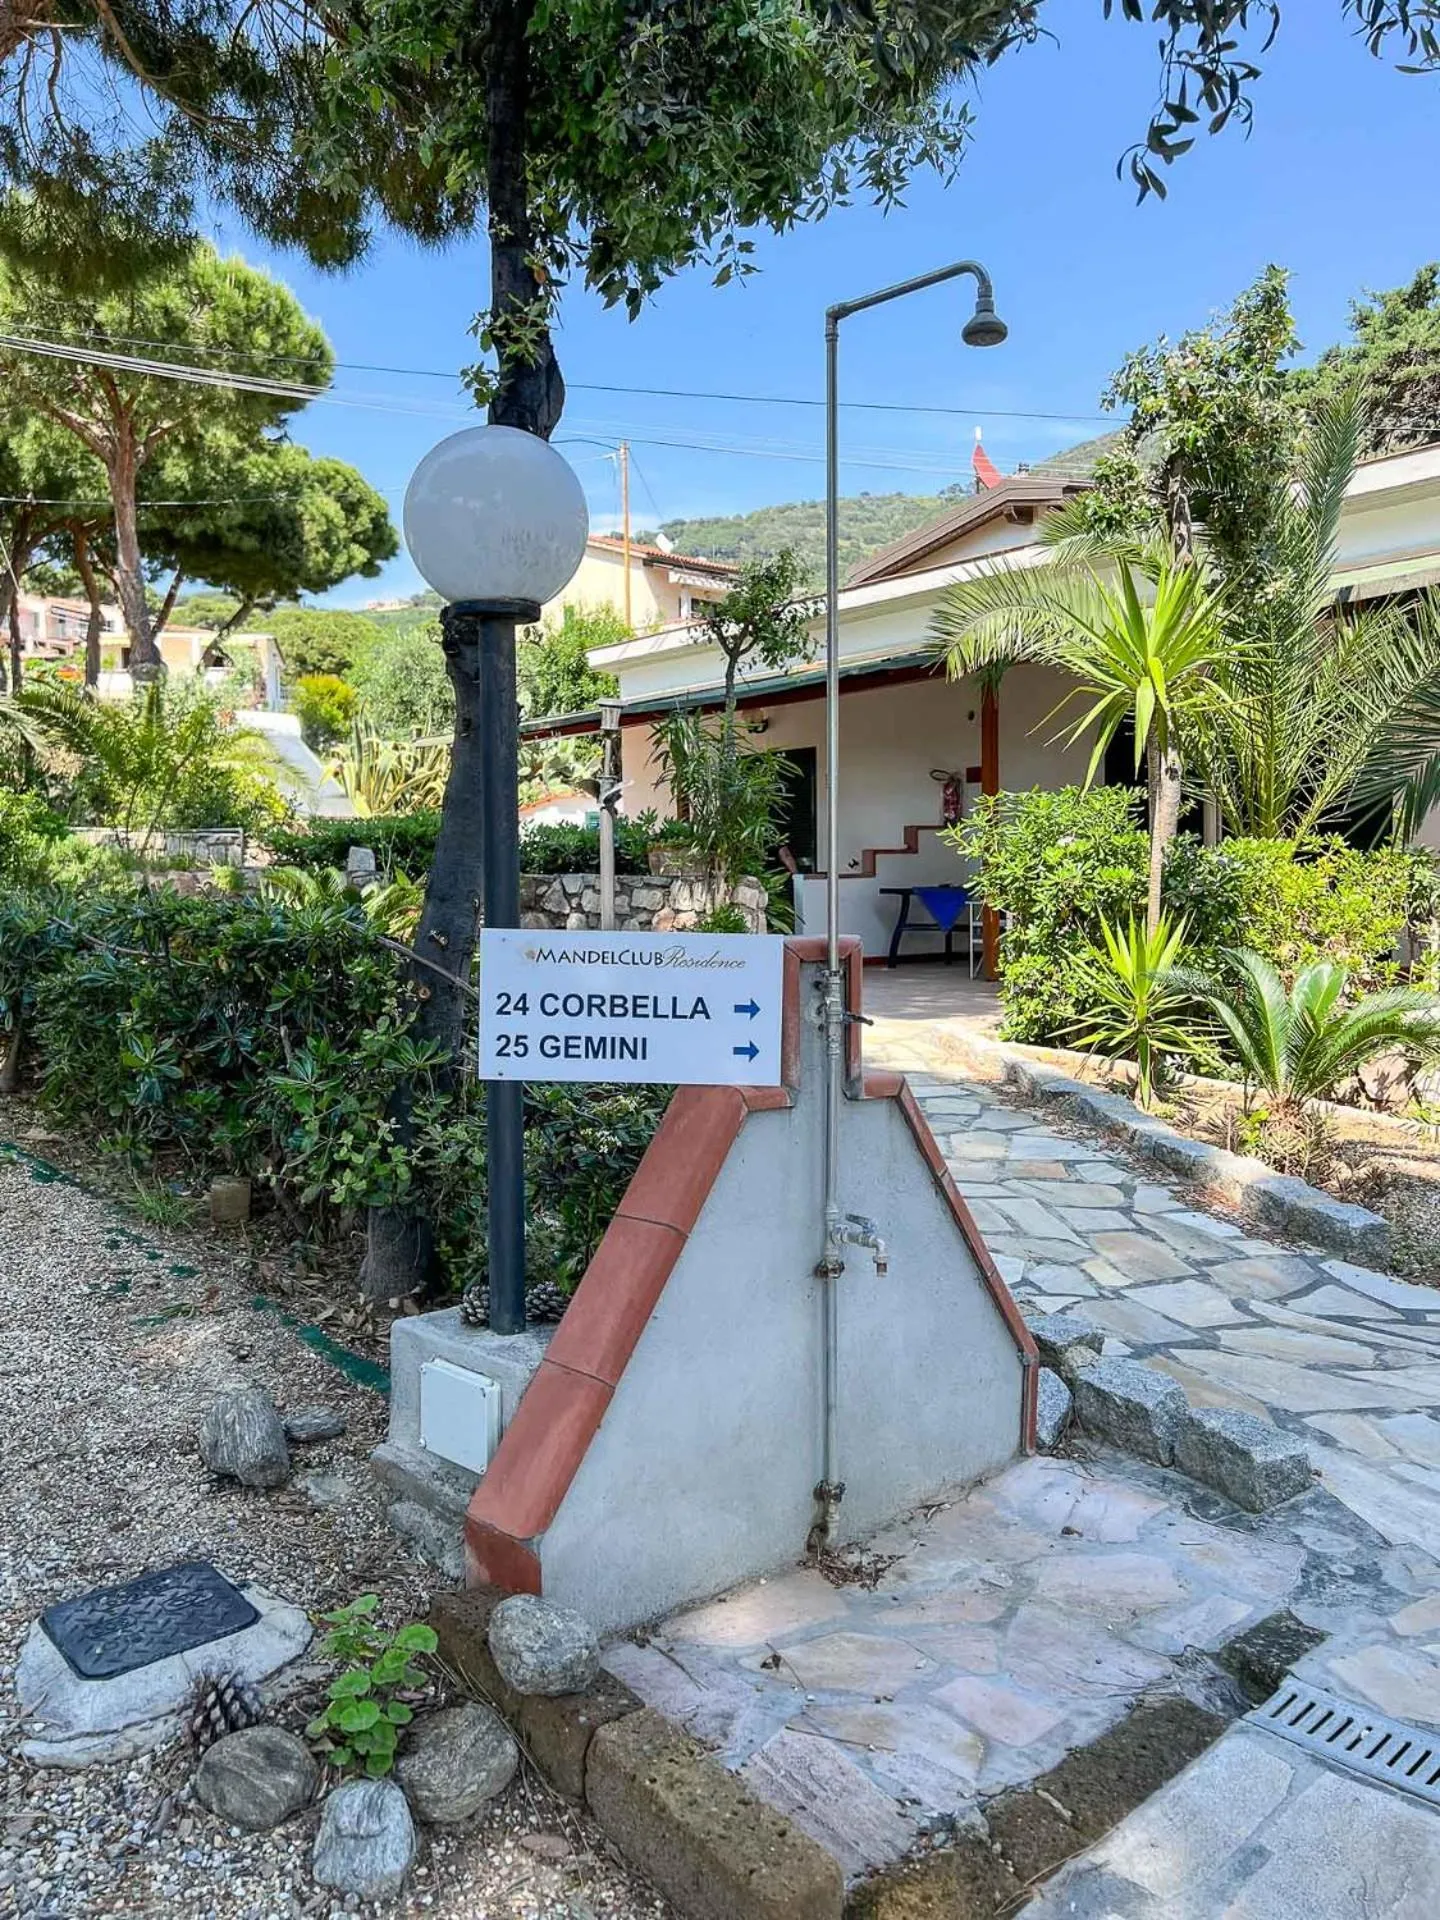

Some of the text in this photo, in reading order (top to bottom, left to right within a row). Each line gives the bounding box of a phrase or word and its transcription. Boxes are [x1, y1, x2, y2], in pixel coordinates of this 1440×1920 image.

[496, 992, 711, 1020] 24 CORBELLA
[496, 1034, 647, 1060] 25 GEMINI
